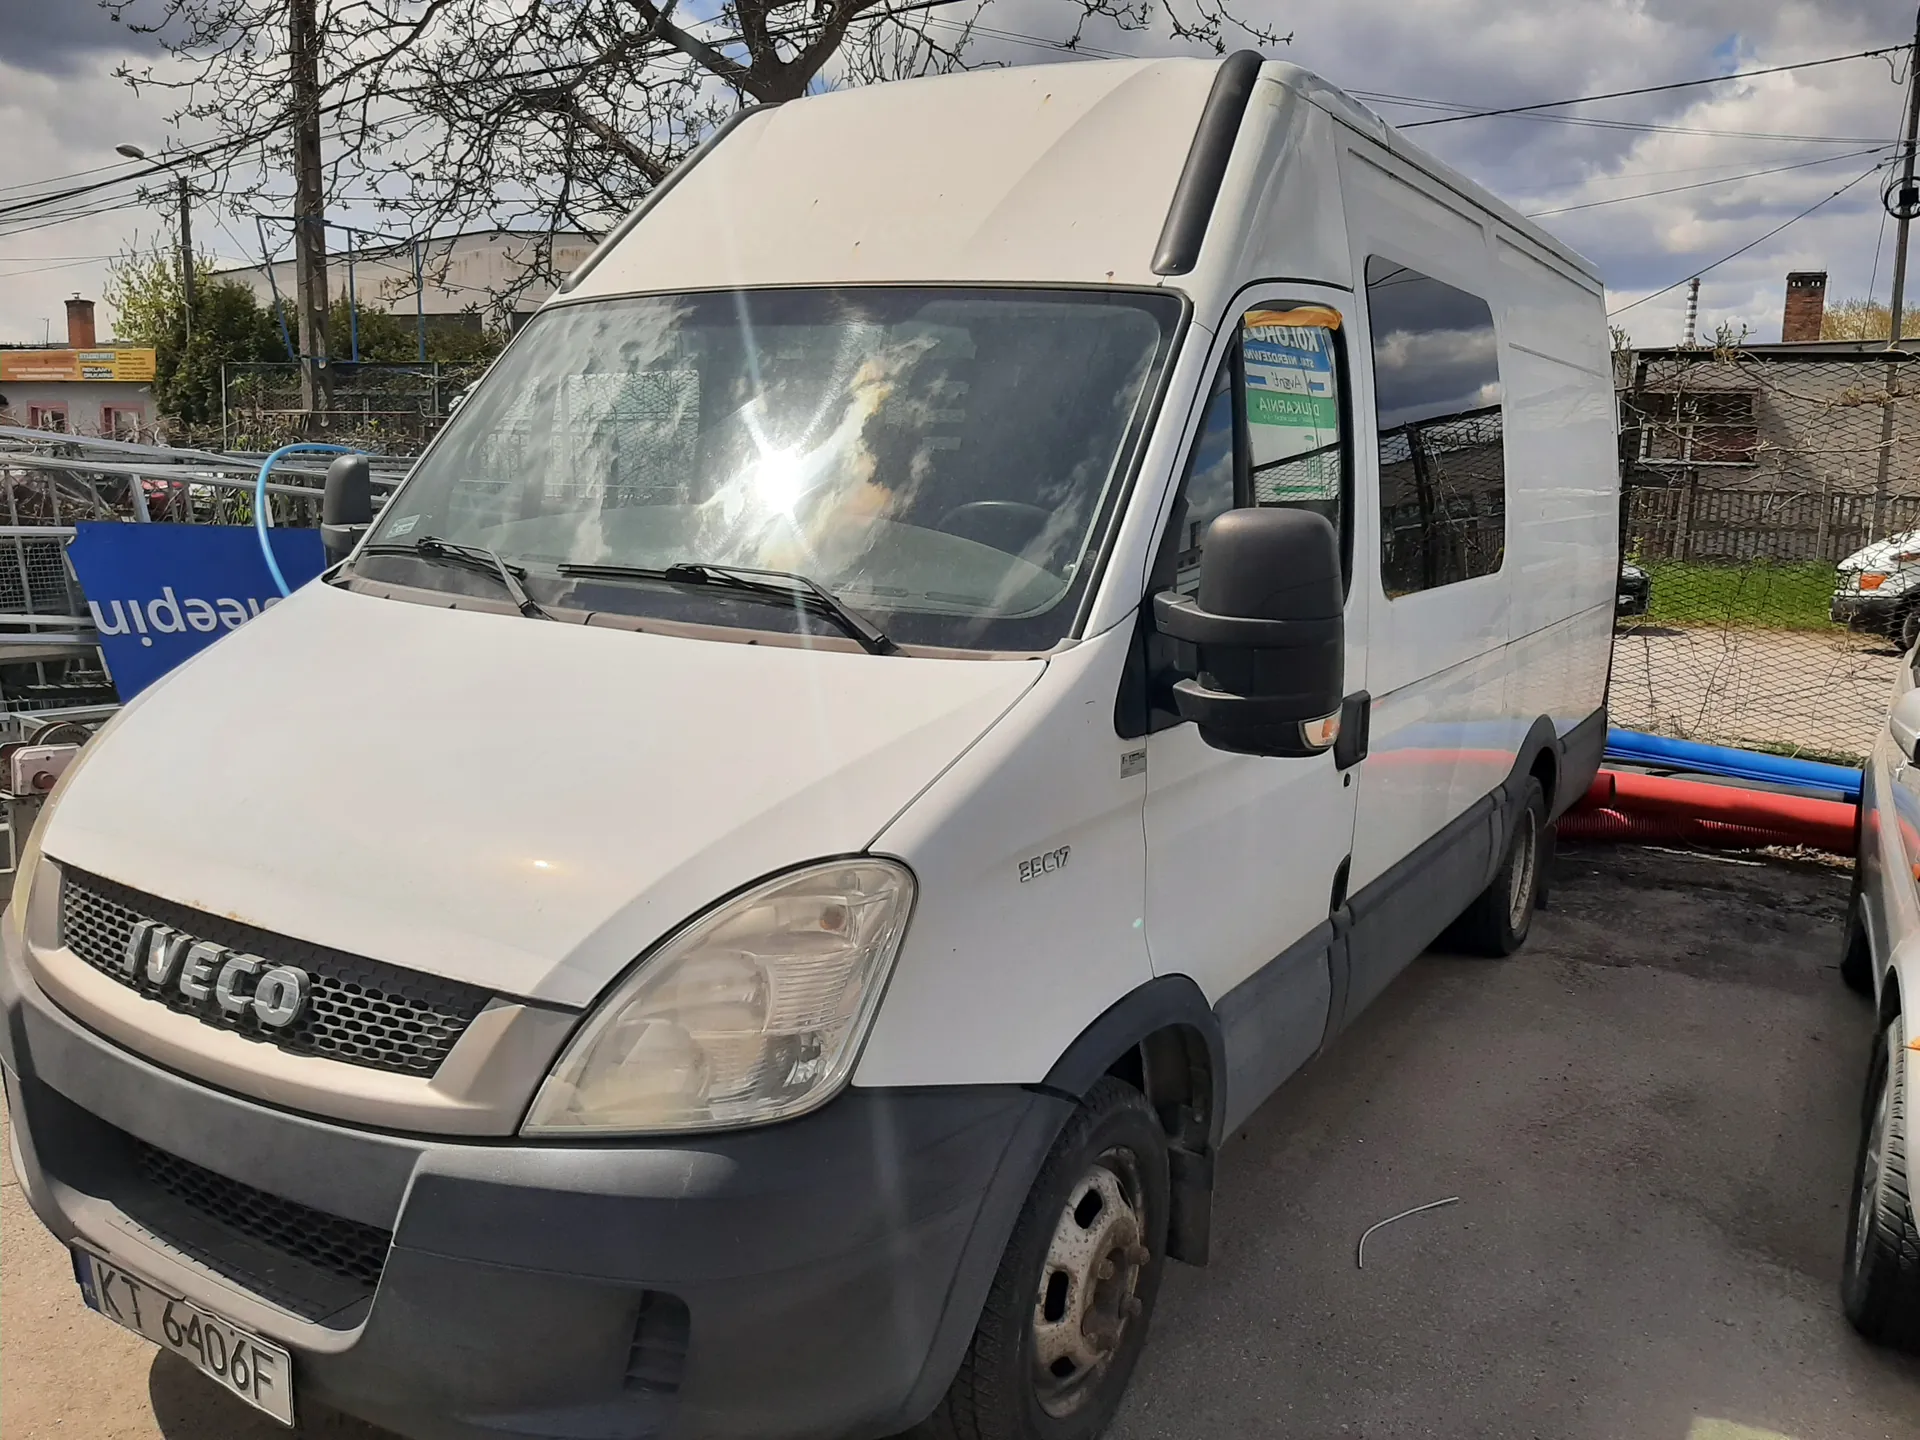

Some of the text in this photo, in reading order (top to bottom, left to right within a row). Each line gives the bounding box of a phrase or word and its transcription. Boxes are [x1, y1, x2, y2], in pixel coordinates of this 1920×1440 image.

[88, 587, 286, 647] eepin
[124, 919, 311, 1027] IVECO
[97, 1262, 274, 1400] KT 6406F
